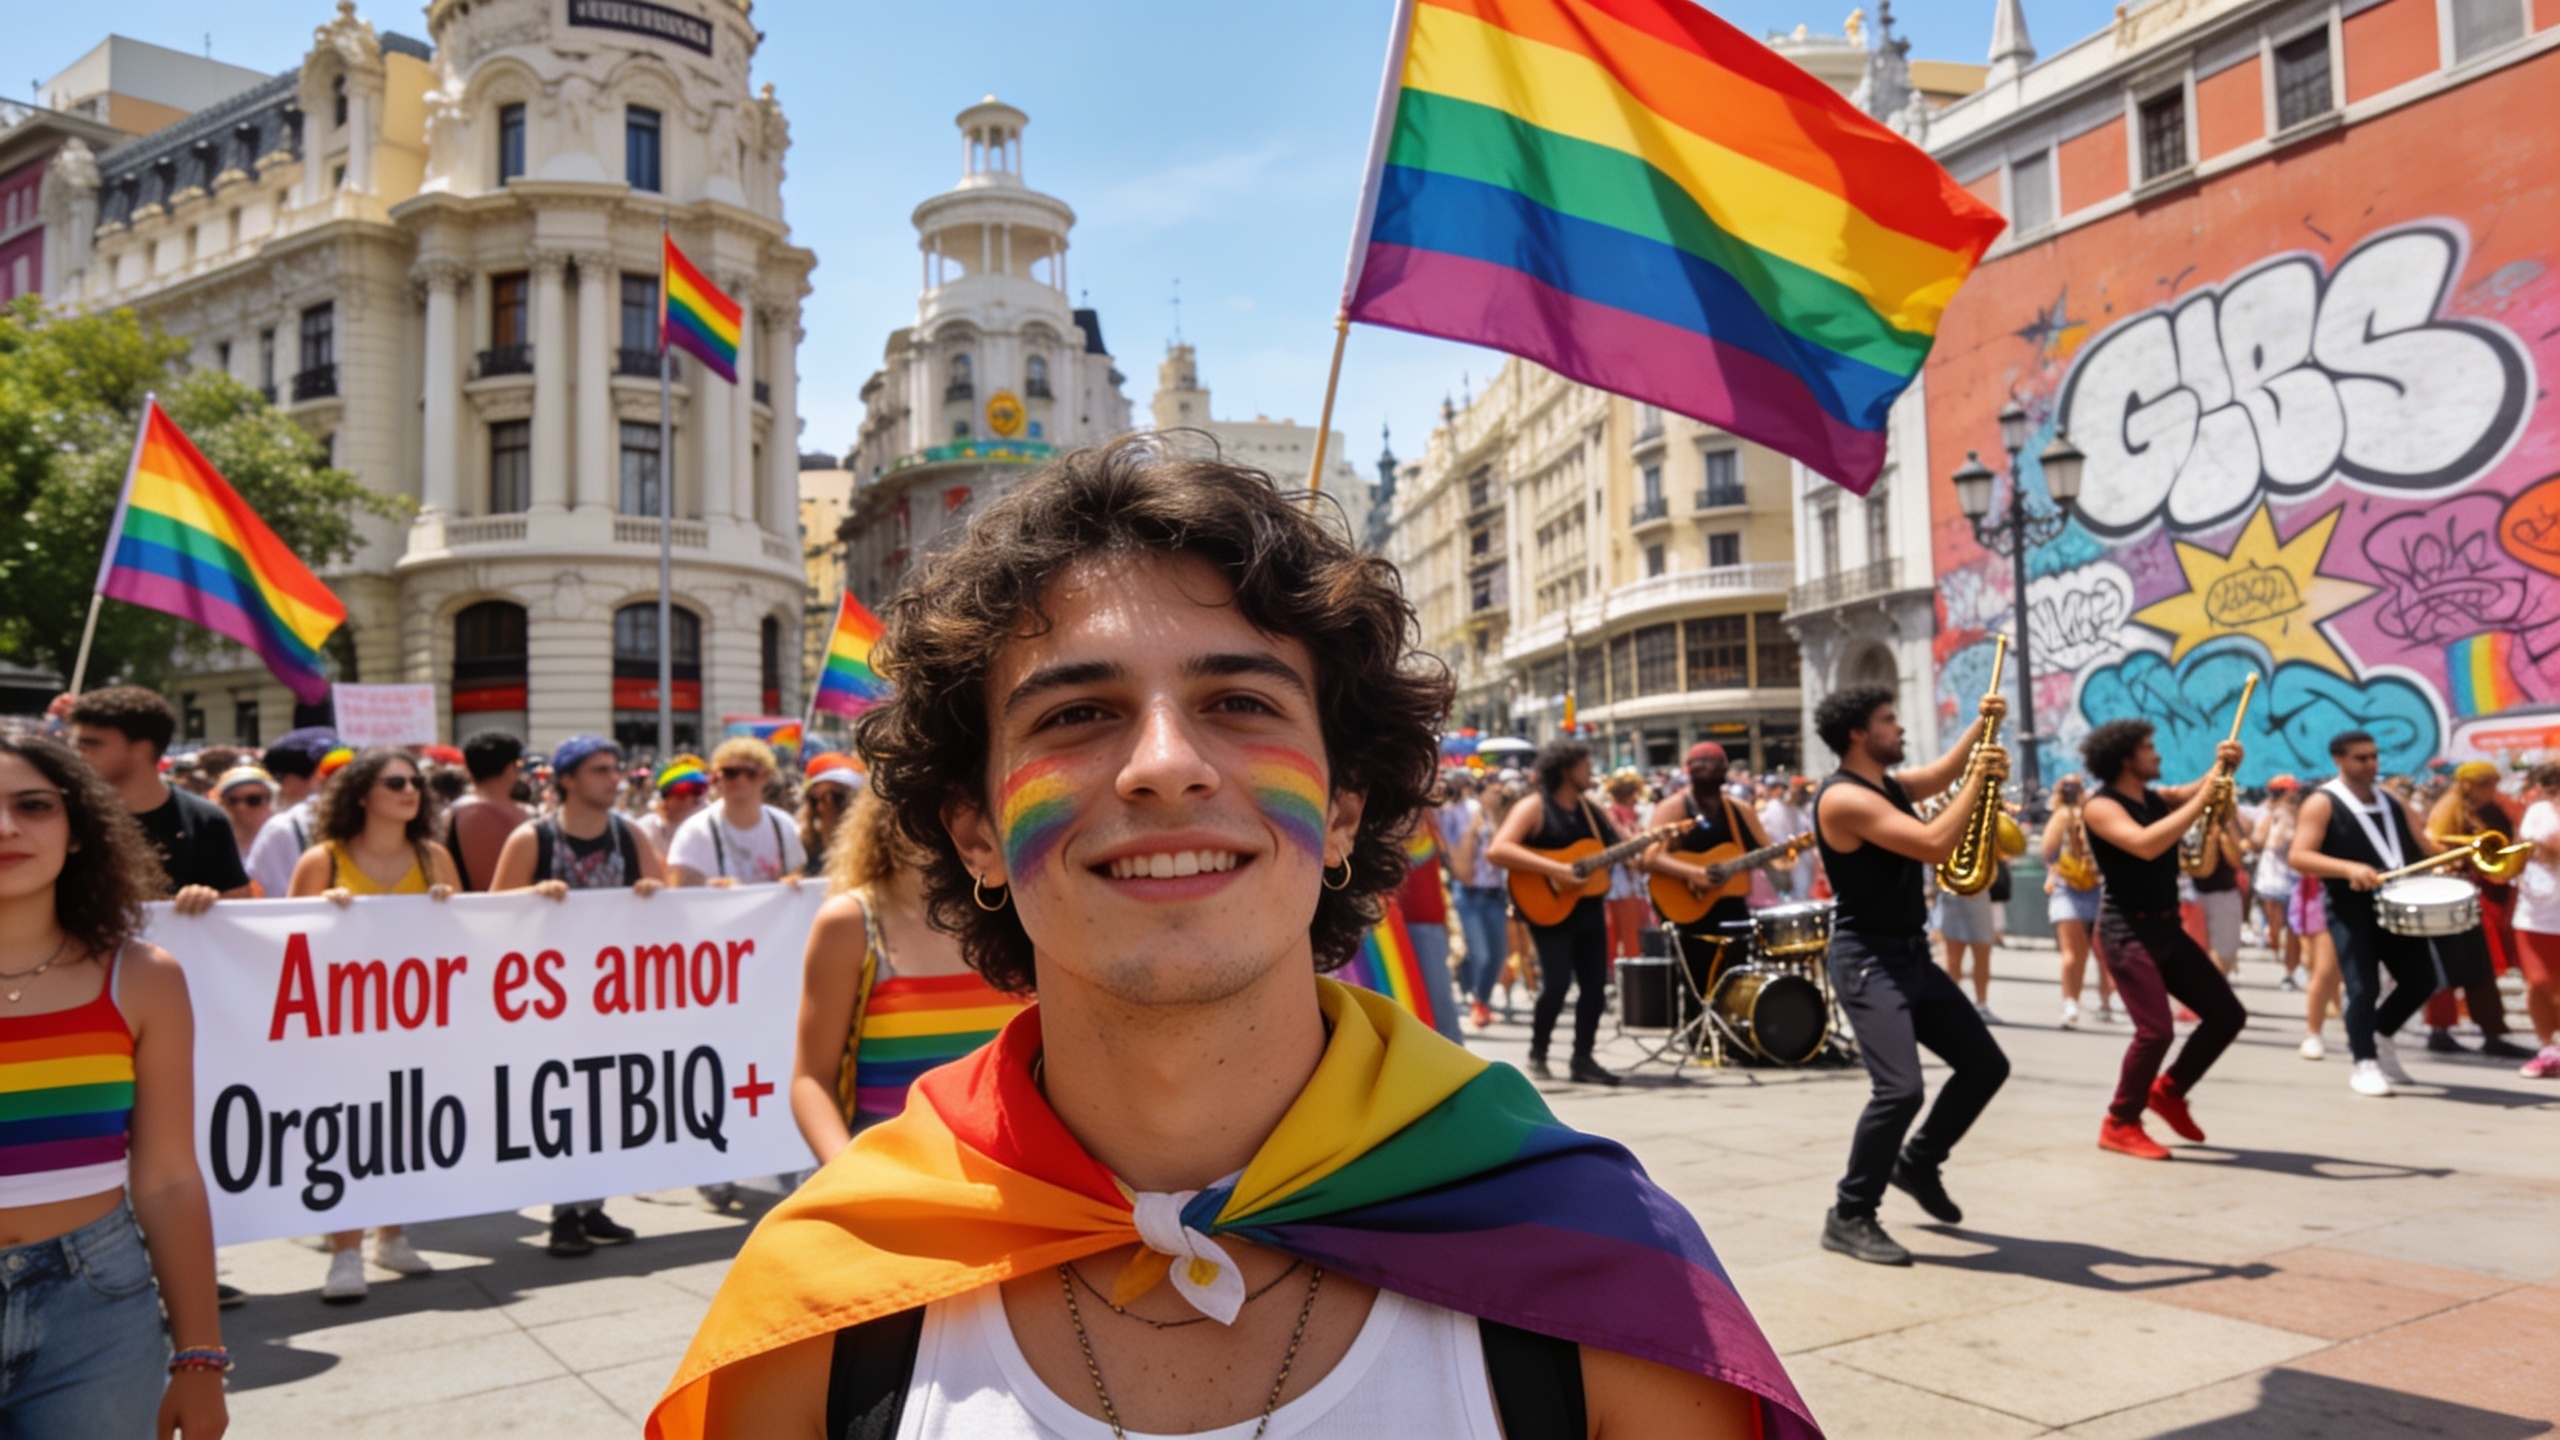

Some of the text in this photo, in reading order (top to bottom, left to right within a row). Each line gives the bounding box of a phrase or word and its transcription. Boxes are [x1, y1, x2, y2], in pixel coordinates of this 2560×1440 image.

[269, 932, 755, 1041] Amor es amor
[209, 1044, 775, 1212] Orgullo LGTBIQ+
